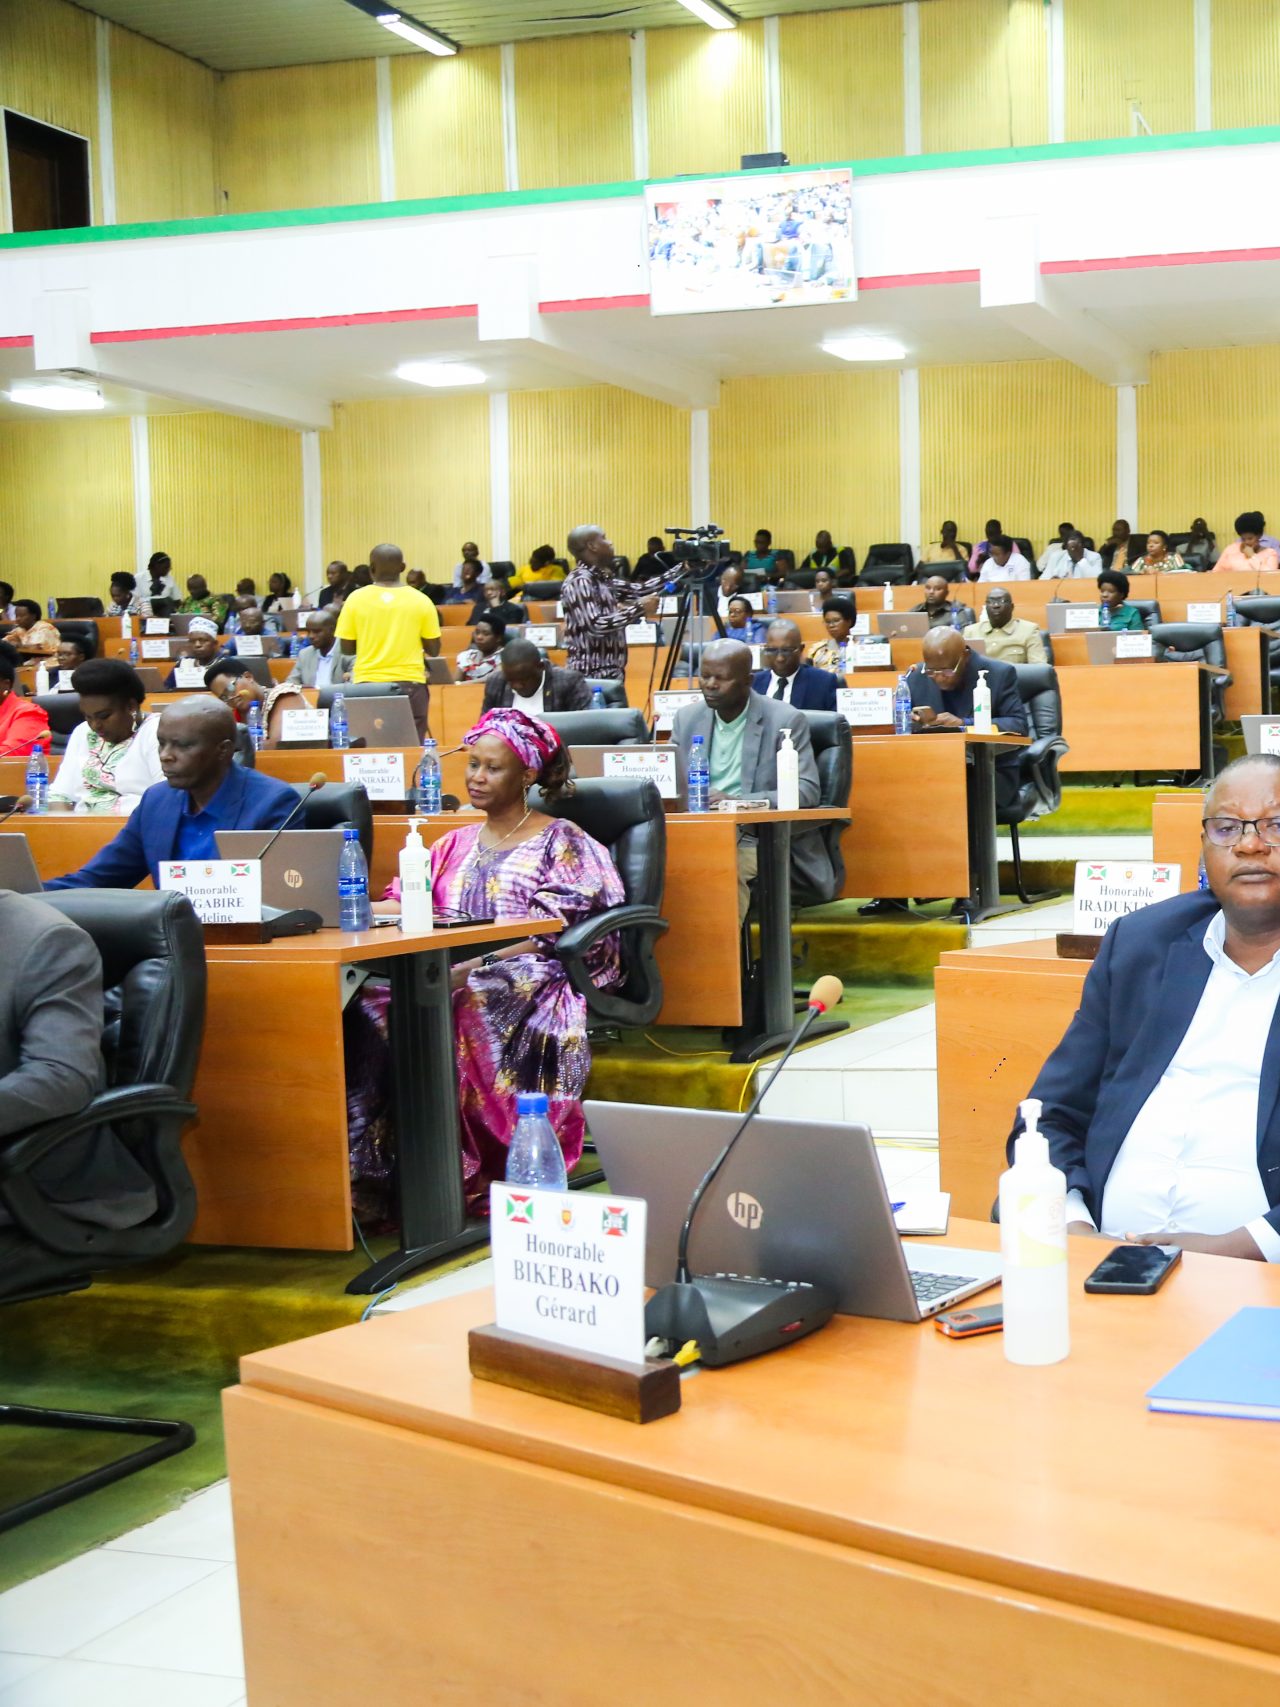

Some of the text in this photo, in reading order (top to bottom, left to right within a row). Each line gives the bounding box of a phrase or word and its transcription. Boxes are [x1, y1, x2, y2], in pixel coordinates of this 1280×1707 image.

[286, 869, 301, 888] hp
[185, 886, 238, 896] Honorable
[1100, 885, 1154, 898] Honorable
[193, 897, 245, 909] GABIRE
[201, 912, 234, 922] deline
[730, 1193, 761, 1229] hp
[526, 1233, 606, 1264] Honorable
[513, 1258, 620, 1298] BIKEBAKO
[535, 1294, 598, 1327] Gérard
